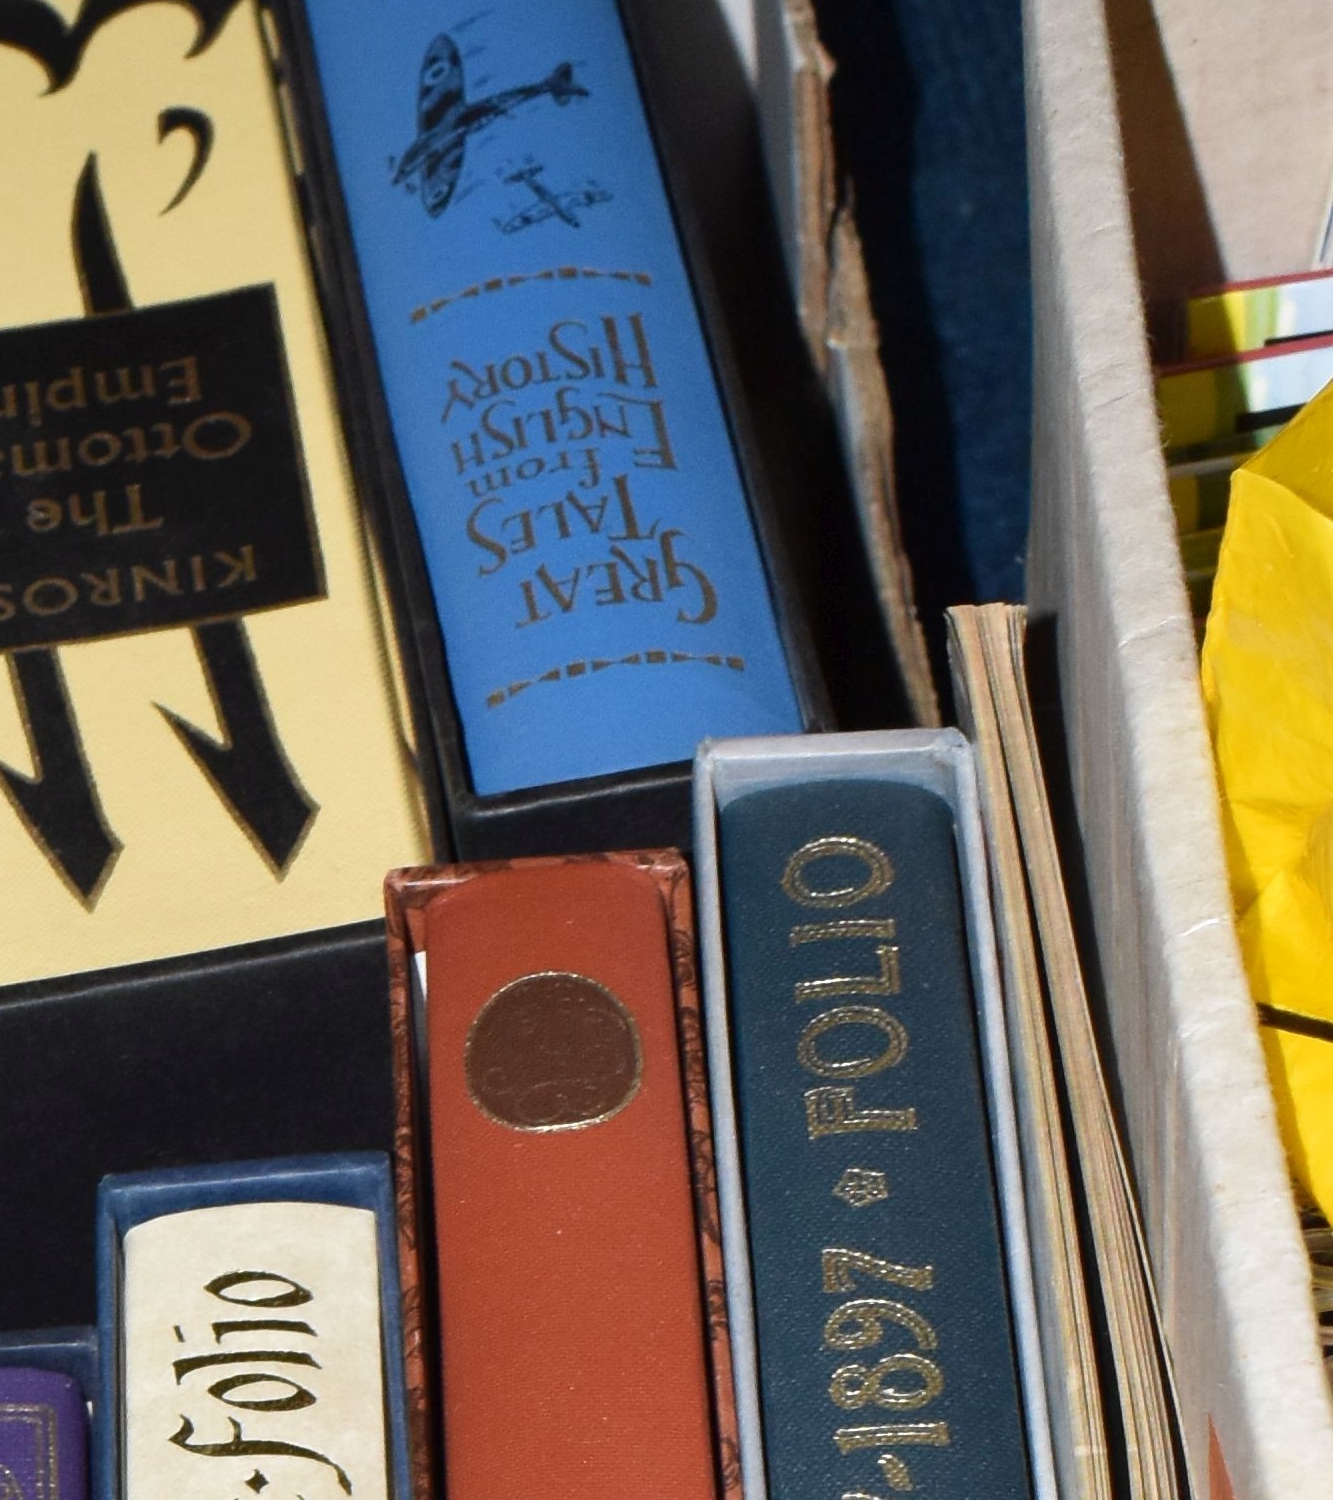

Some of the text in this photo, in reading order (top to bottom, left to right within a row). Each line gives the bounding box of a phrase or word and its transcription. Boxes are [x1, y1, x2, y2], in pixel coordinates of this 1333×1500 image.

[439, 311, 660, 423] HISTORY
[449, 389, 679, 477] ENGLISH
[465, 447, 601, 498] from
[24, 489, 164, 538] The
[463, 472, 664, 578] TALES
[514, 528, 721, 629] GREAT
[780, 832, 921, 1142] FOLIO
